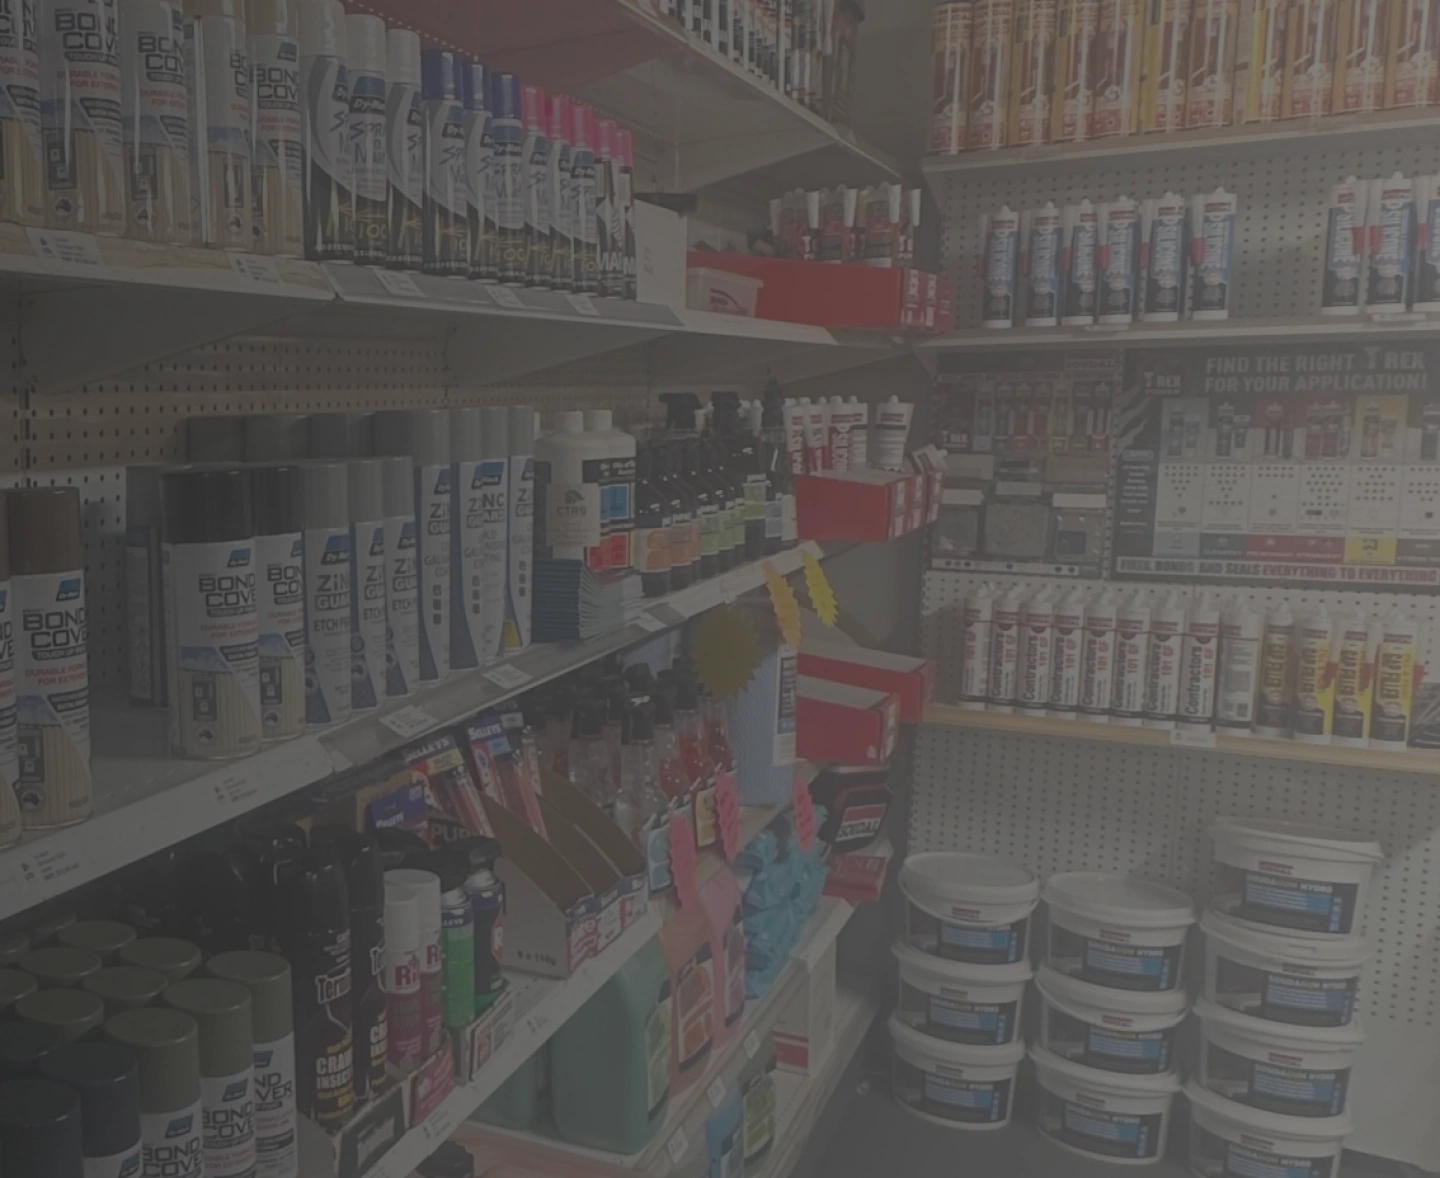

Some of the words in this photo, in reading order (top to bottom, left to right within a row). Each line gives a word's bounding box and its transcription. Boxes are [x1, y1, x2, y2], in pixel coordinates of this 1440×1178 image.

[1205, 356, 1251, 374] FIND
[1256, 356, 1293, 374] THE
[1294, 353, 1356, 373] RIGHT
[1363, 346, 1381, 370] T
[1383, 351, 1426, 370] REX
[1157, 374, 1182, 388] REX
[1204, 375, 1241, 393] FOR
[1243, 375, 1291, 393] YOUR
[1293, 372, 1428, 392] APPLICATION!
[1225, 562, 1262, 575] SEALS
[1262, 563, 1337, 578] EVERYTHING
[1340, 567, 1356, 580] TO
[1358, 568, 1437, 584] EVERYTHING
[30, 627, 87, 650] COVE
[1023, 635, 1039, 701] Contractors
[1082, 639, 1098, 705] Contractors
[1146, 643, 1161, 711] Contractors
[1185, 645, 1202, 715] Contractors
[839, 820, 879, 838] SOUDAL
[255, 1080, 293, 1101] VER
